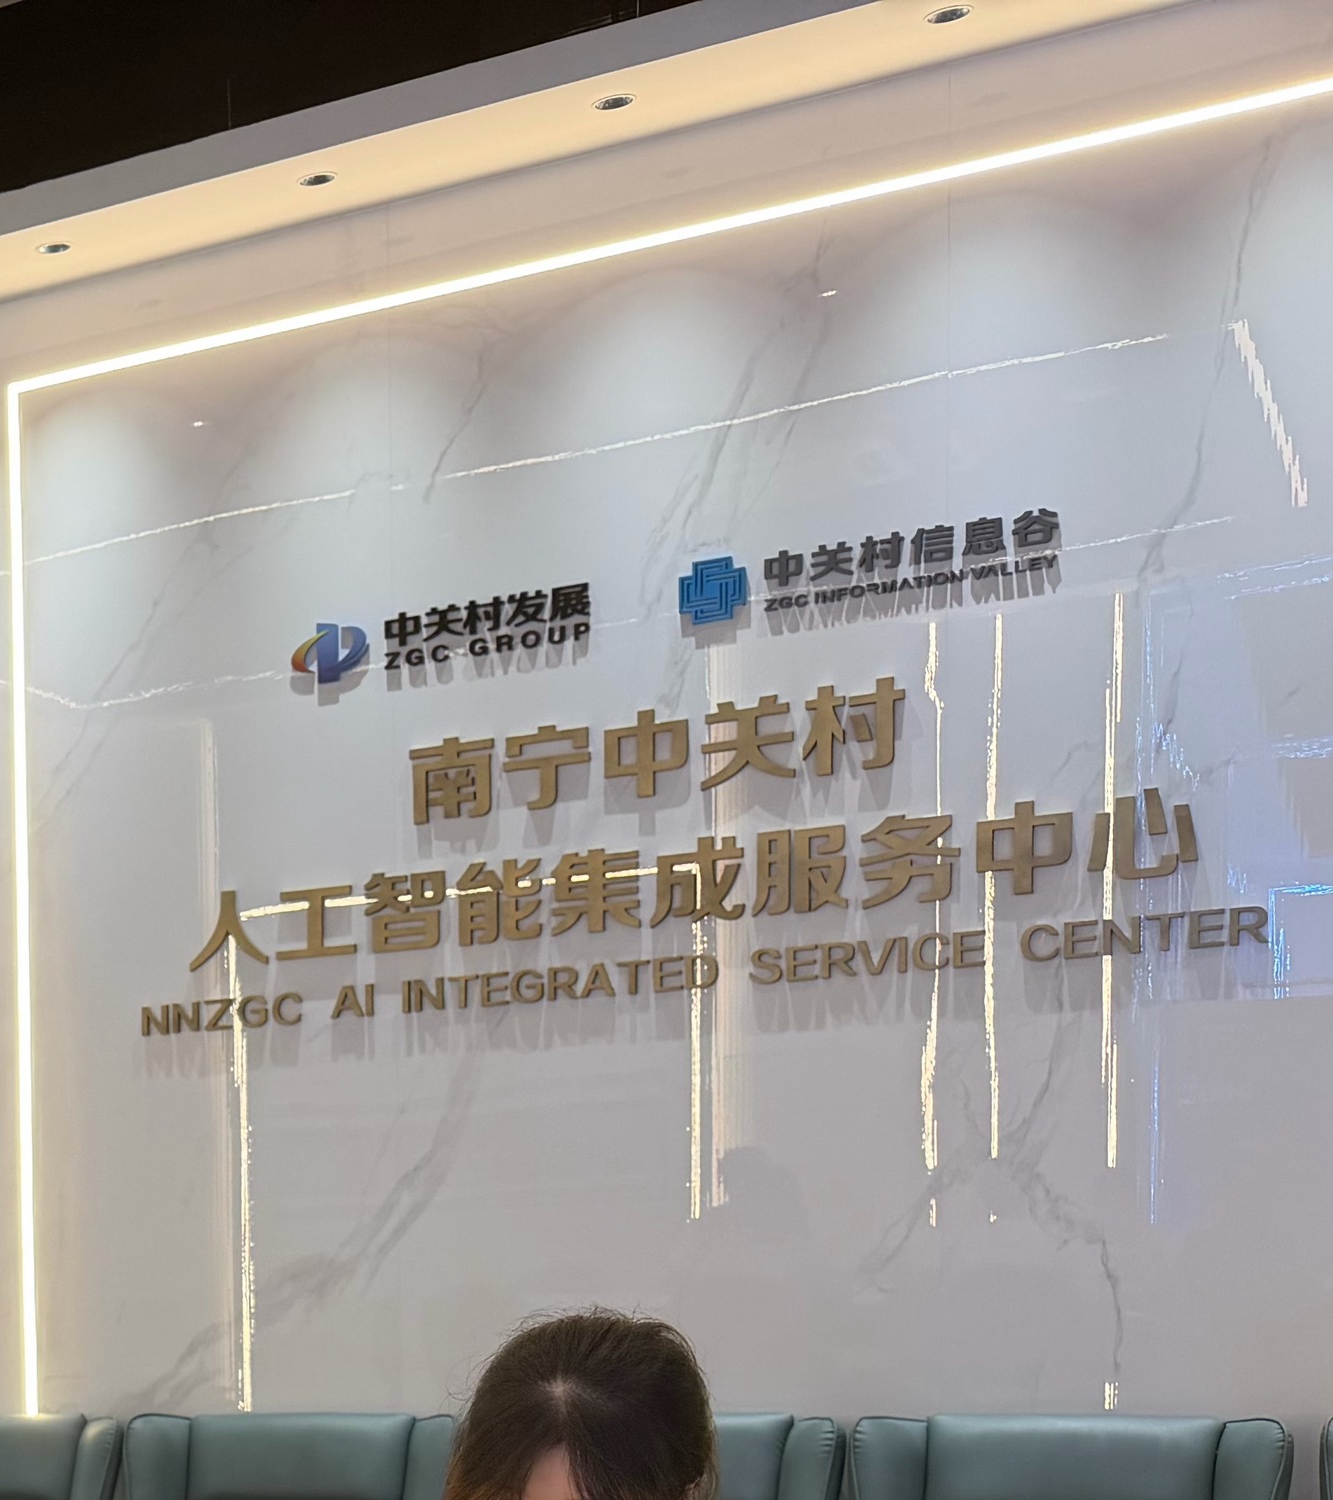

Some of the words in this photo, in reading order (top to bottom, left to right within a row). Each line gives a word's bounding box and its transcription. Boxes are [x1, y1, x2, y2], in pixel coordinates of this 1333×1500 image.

[763, 593, 809, 612] ZGC
[814, 568, 965, 605] INFORMATION
[970, 555, 1058, 581] VALLEY
[764, 508, 1060, 587] 中关村信息谷
[384, 582, 591, 647] 中关村发展
[384, 644, 451, 671] ZGC
[468, 622, 591, 657] GROUP
[408, 677, 906, 826] 南宁中关村
[190, 786, 1200, 973] 人工智能集成服务中心
[140, 992, 303, 1037] NNZGC
[331, 983, 375, 1021] AI
[401, 954, 720, 1014] INTEGRATED
[749, 929, 987, 985] SERVICE
[1020, 905, 1271, 963] CENTER
